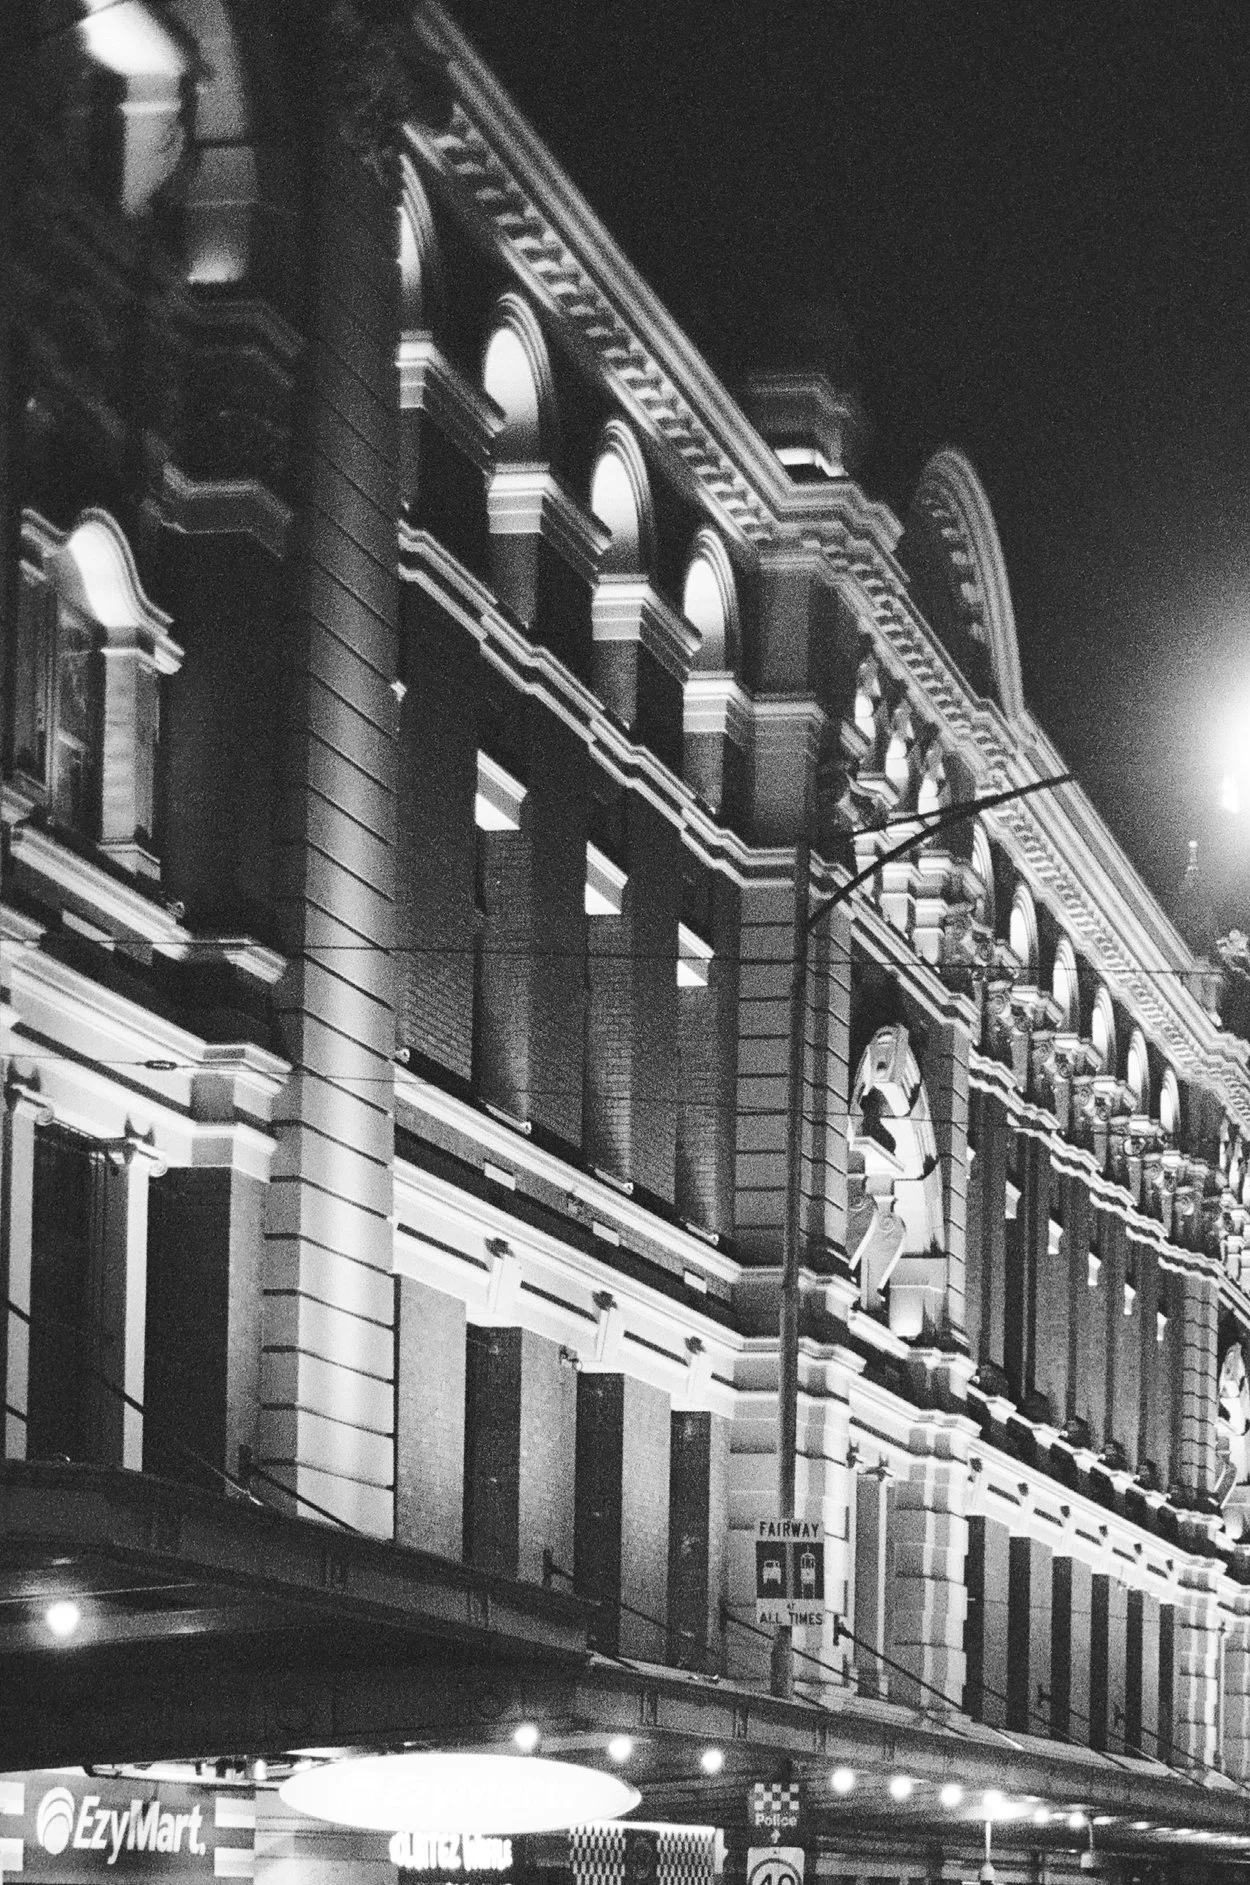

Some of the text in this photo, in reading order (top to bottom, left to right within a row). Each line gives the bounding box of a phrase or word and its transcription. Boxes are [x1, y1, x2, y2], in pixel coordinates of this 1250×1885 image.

[760, 1521, 819, 1538] FAIRWAY
[760, 1612, 823, 1626] ALL TIMES
[755, 1813, 798, 1827] Police
